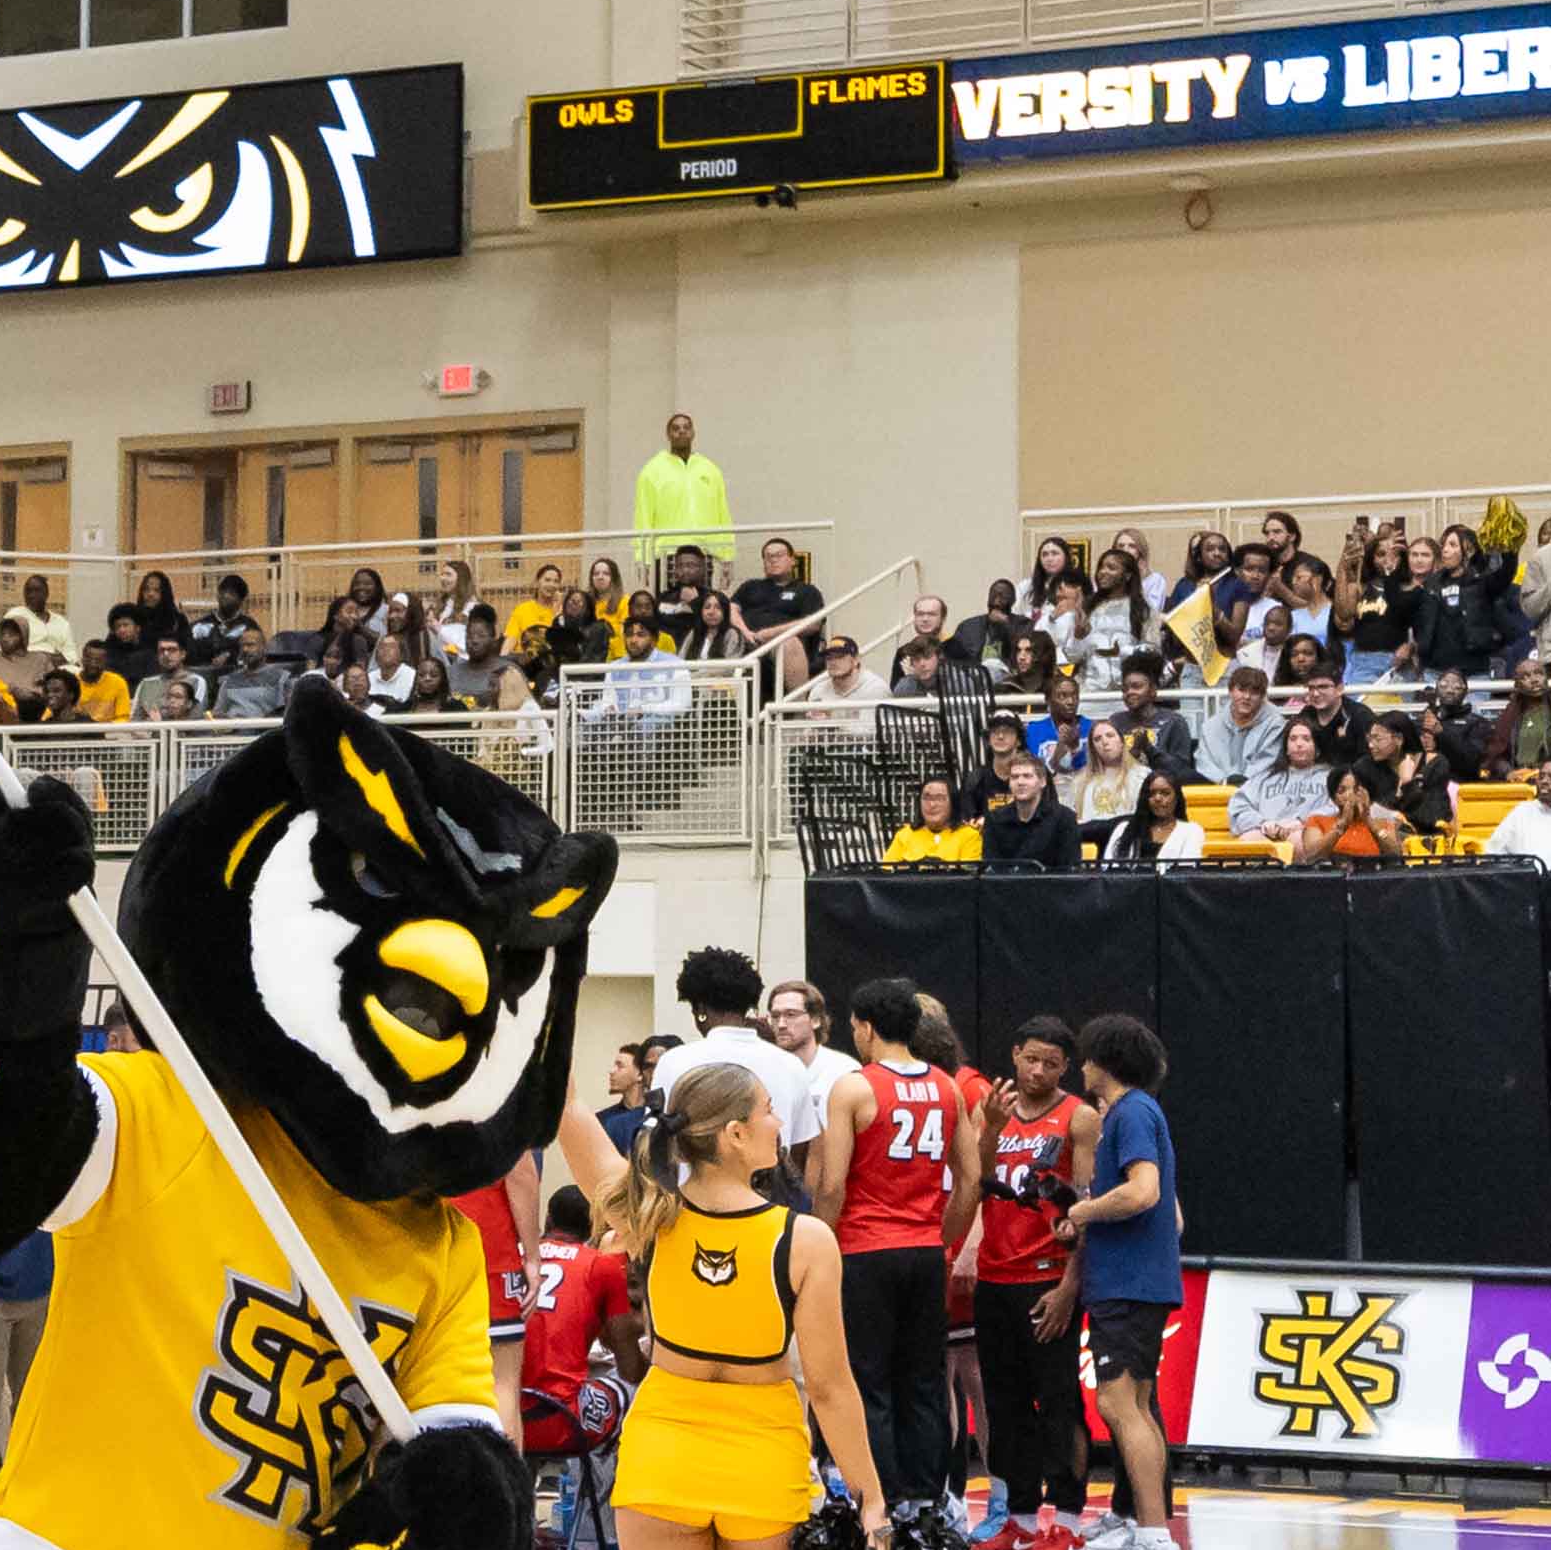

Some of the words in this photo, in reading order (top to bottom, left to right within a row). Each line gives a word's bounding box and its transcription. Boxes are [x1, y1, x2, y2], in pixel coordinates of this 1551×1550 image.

[810, 72, 926, 105] FLAMES
[951, 54, 1251, 141] VERSITY
[559, 99, 634, 129] OWLS
[680, 157, 737, 180] PERIOD
[212, 385, 238, 407] EXIT
[888, 1108, 945, 1161] 24
[996, 1133, 1047, 1159] Liberty
[536, 1263, 564, 1309] 2
